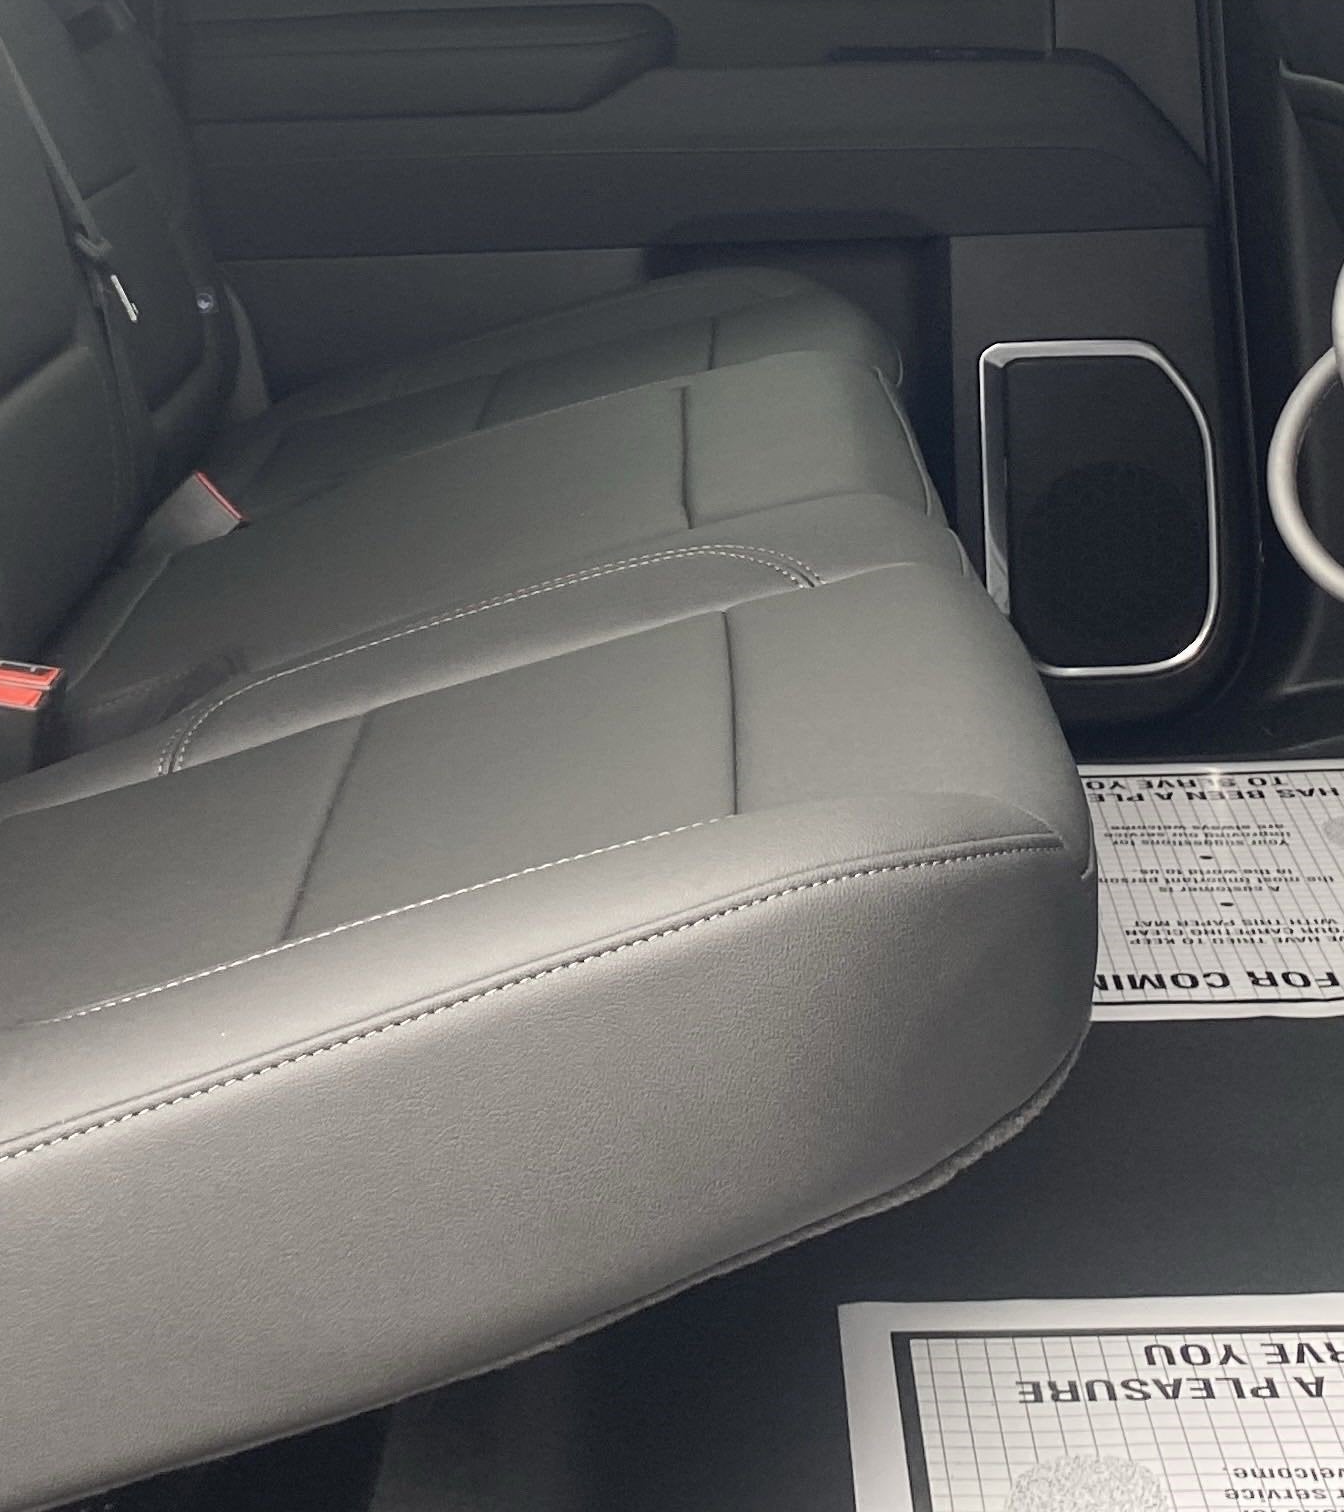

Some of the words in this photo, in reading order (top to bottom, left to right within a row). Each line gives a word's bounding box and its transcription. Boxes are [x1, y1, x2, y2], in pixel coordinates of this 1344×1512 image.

[1246, 776, 1287, 788] TO
[1153, 791, 1174, 802] A
[1185, 789, 1265, 801] BEEN
[1275, 787, 1340, 799] HAS
[1164, 876, 1251, 884] important
[1257, 876, 1300, 884] most
[1307, 875, 1334, 883] the
[1133, 920, 1170, 928] MAT
[1176, 919, 1235, 927] PAPER
[1242, 919, 1281, 927] THIS
[1289, 918, 1336, 926] WITH
[1125, 929, 1183, 937] CLEAN
[1190, 927, 1294, 936] CARPETING
[1128, 937, 1176, 945] KEEP
[1182, 937, 1204, 945] TO
[1212, 937, 1265, 945] TRIED
[1273, 936, 1320, 944] HAVE
[1245, 971, 1341, 989] FOR
[1143, 1342, 1248, 1367] YOU
[1017, 1376, 1282, 1405] PLEASURE
[1293, 1375, 1326, 1399] A
[1223, 1488, 1327, 1503] service
